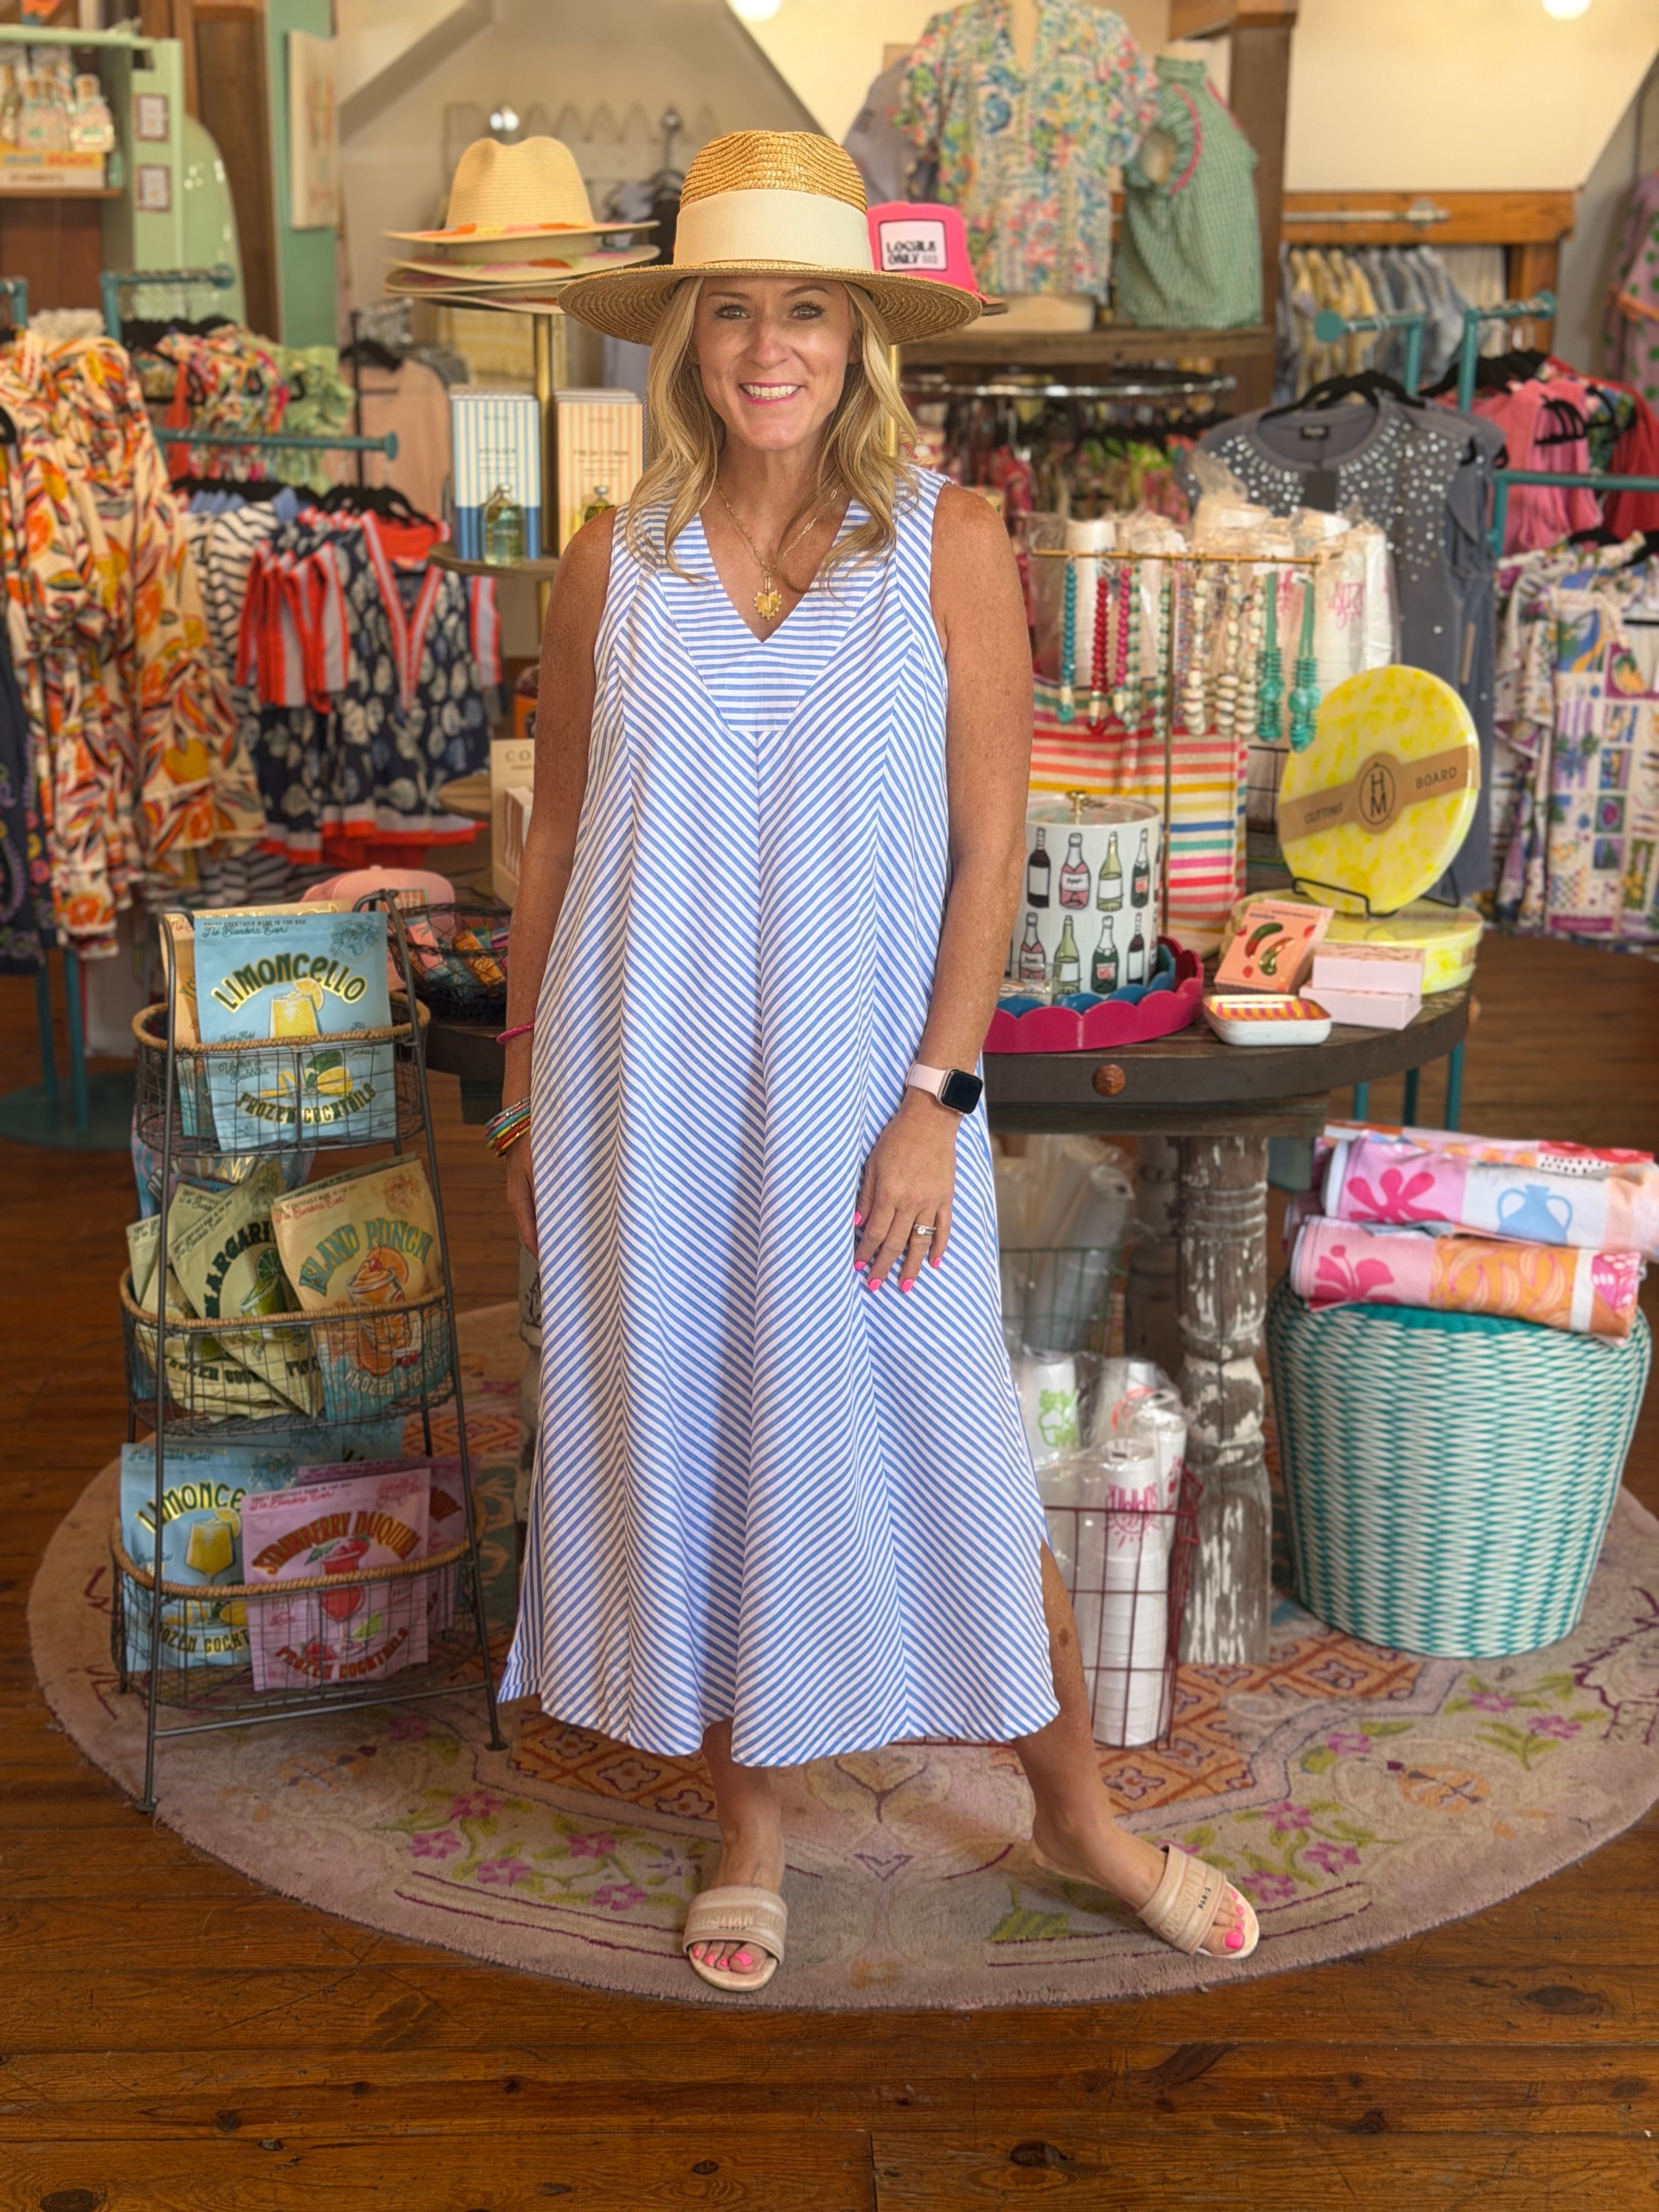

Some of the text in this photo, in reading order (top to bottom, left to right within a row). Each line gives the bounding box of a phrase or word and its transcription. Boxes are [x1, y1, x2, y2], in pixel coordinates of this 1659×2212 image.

[888, 253, 919, 265] ONLY
[1415, 766, 1458, 789] BOARD
[1304, 802, 1344, 824] CUTTING
[201, 927, 220, 938] No
[222, 925, 262, 938] Blenders
[211, 952, 367, 1013] LIMONCELLO
[236, 1082, 378, 1125] FROZEN COCKTAILS
[299, 1217, 433, 1297] ISLAND PUNCH
[251, 1511, 352, 1576] STRAWBERRY
[275, 1646, 334, 1680] FROZEN
[1198, 1887, 1211, 1909] PARIS
